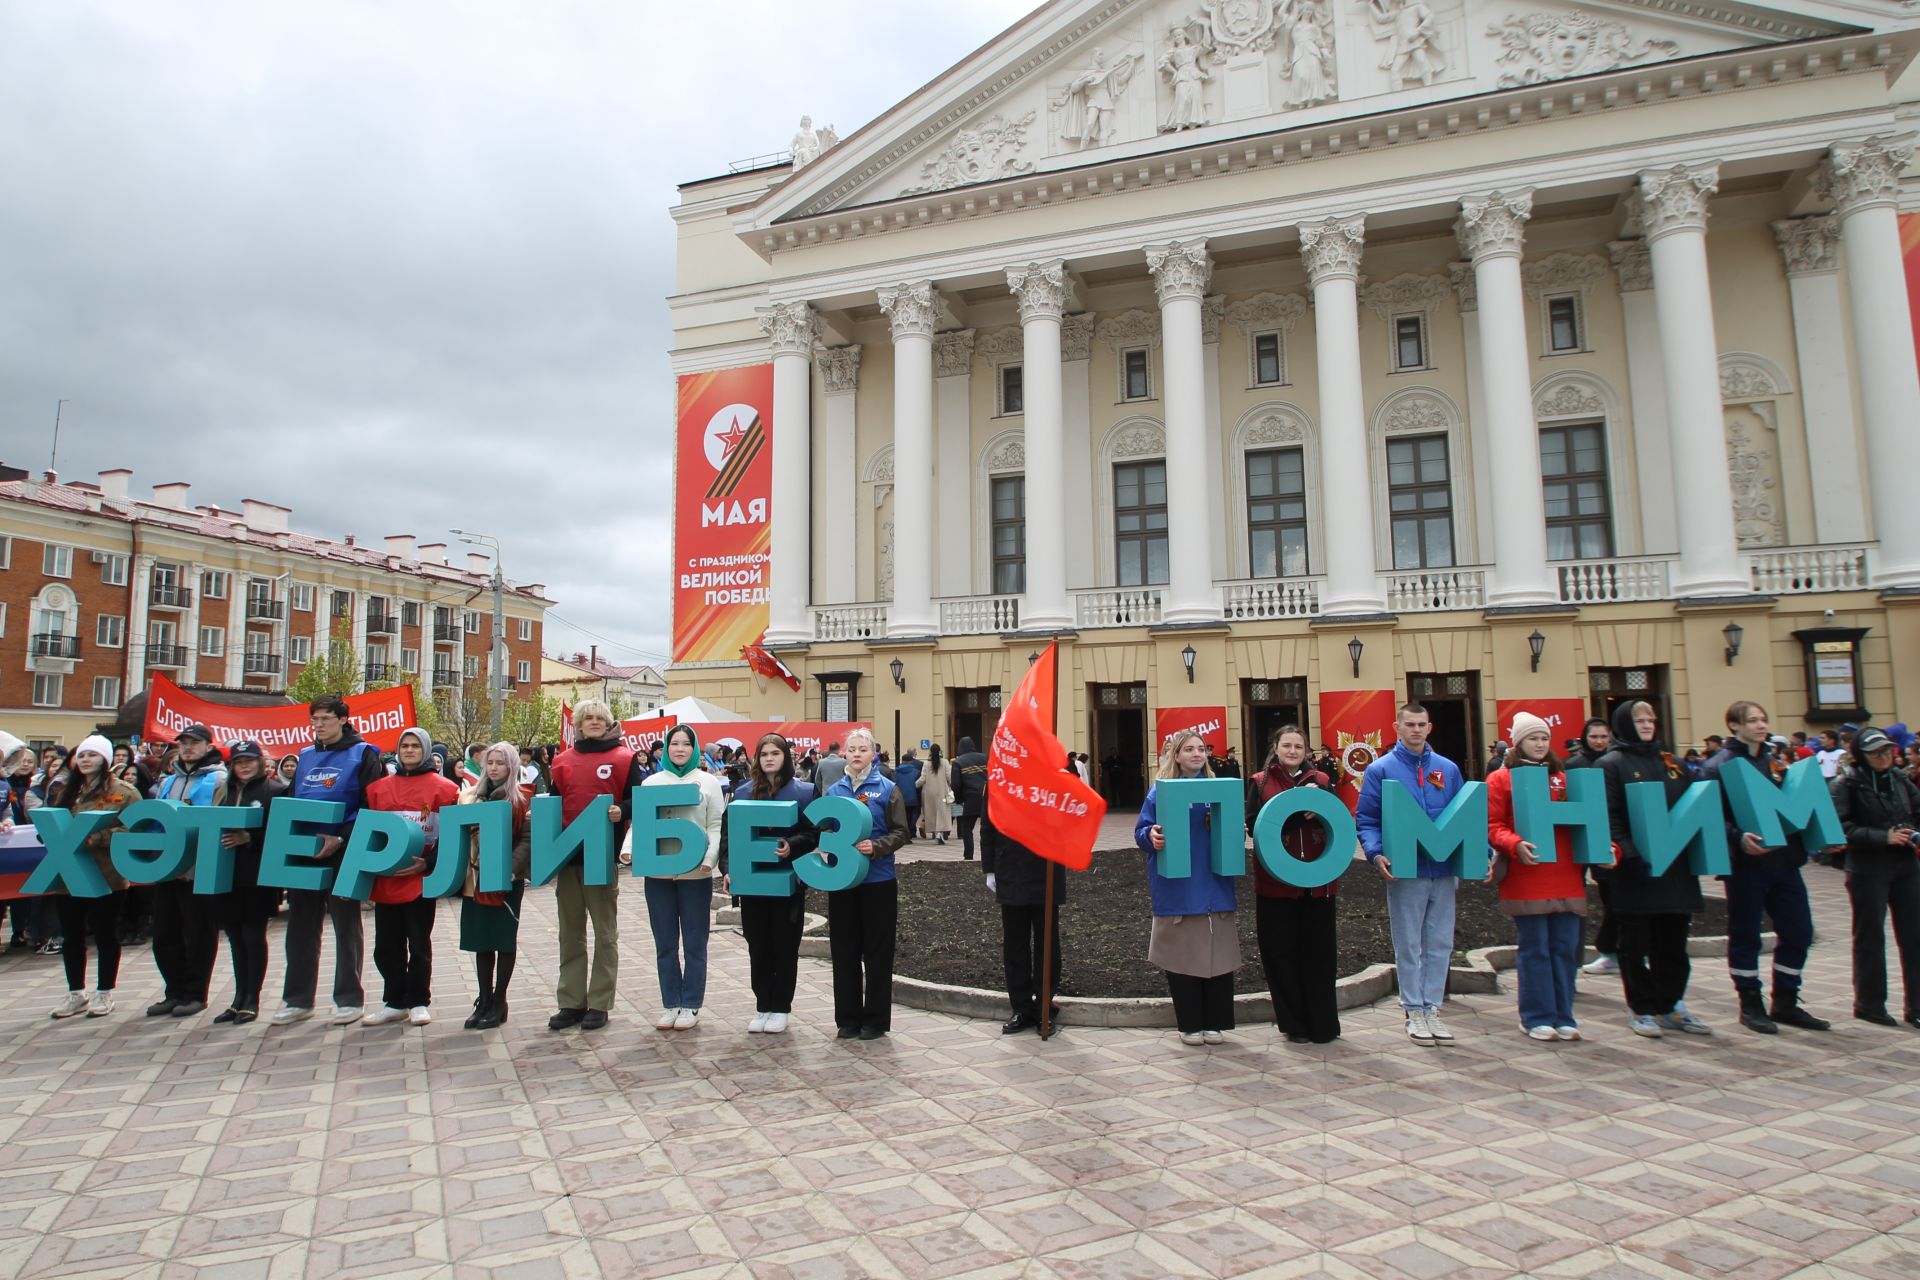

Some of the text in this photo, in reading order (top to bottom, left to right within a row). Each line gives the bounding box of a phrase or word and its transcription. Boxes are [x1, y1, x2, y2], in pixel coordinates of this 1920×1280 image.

[701, 498, 766, 528] МАЯ
[681, 565, 762, 589] ВЕЛИКОЙ
[156, 697, 204, 733] Слав
[210, 724, 317, 746] труженик
[1155, 756, 1847, 888] ПОМНИМ
